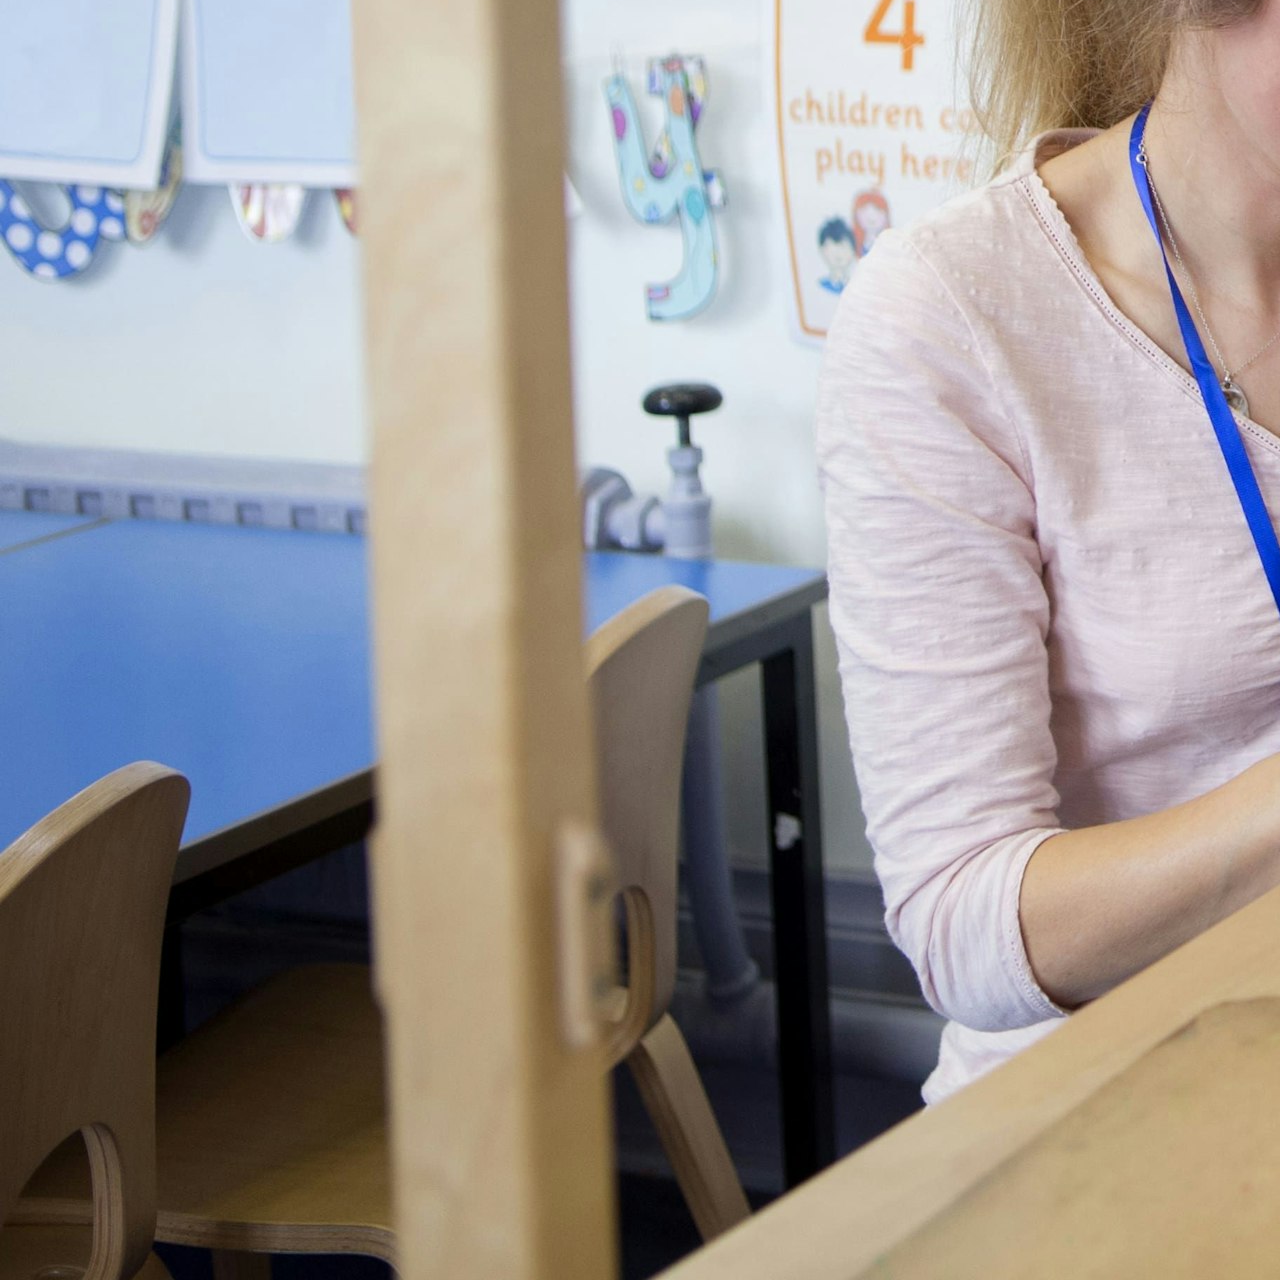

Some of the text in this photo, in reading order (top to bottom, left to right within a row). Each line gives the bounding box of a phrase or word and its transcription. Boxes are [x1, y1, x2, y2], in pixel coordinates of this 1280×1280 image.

[788, 86, 995, 136] children ca
[814, 137, 976, 188] play here
